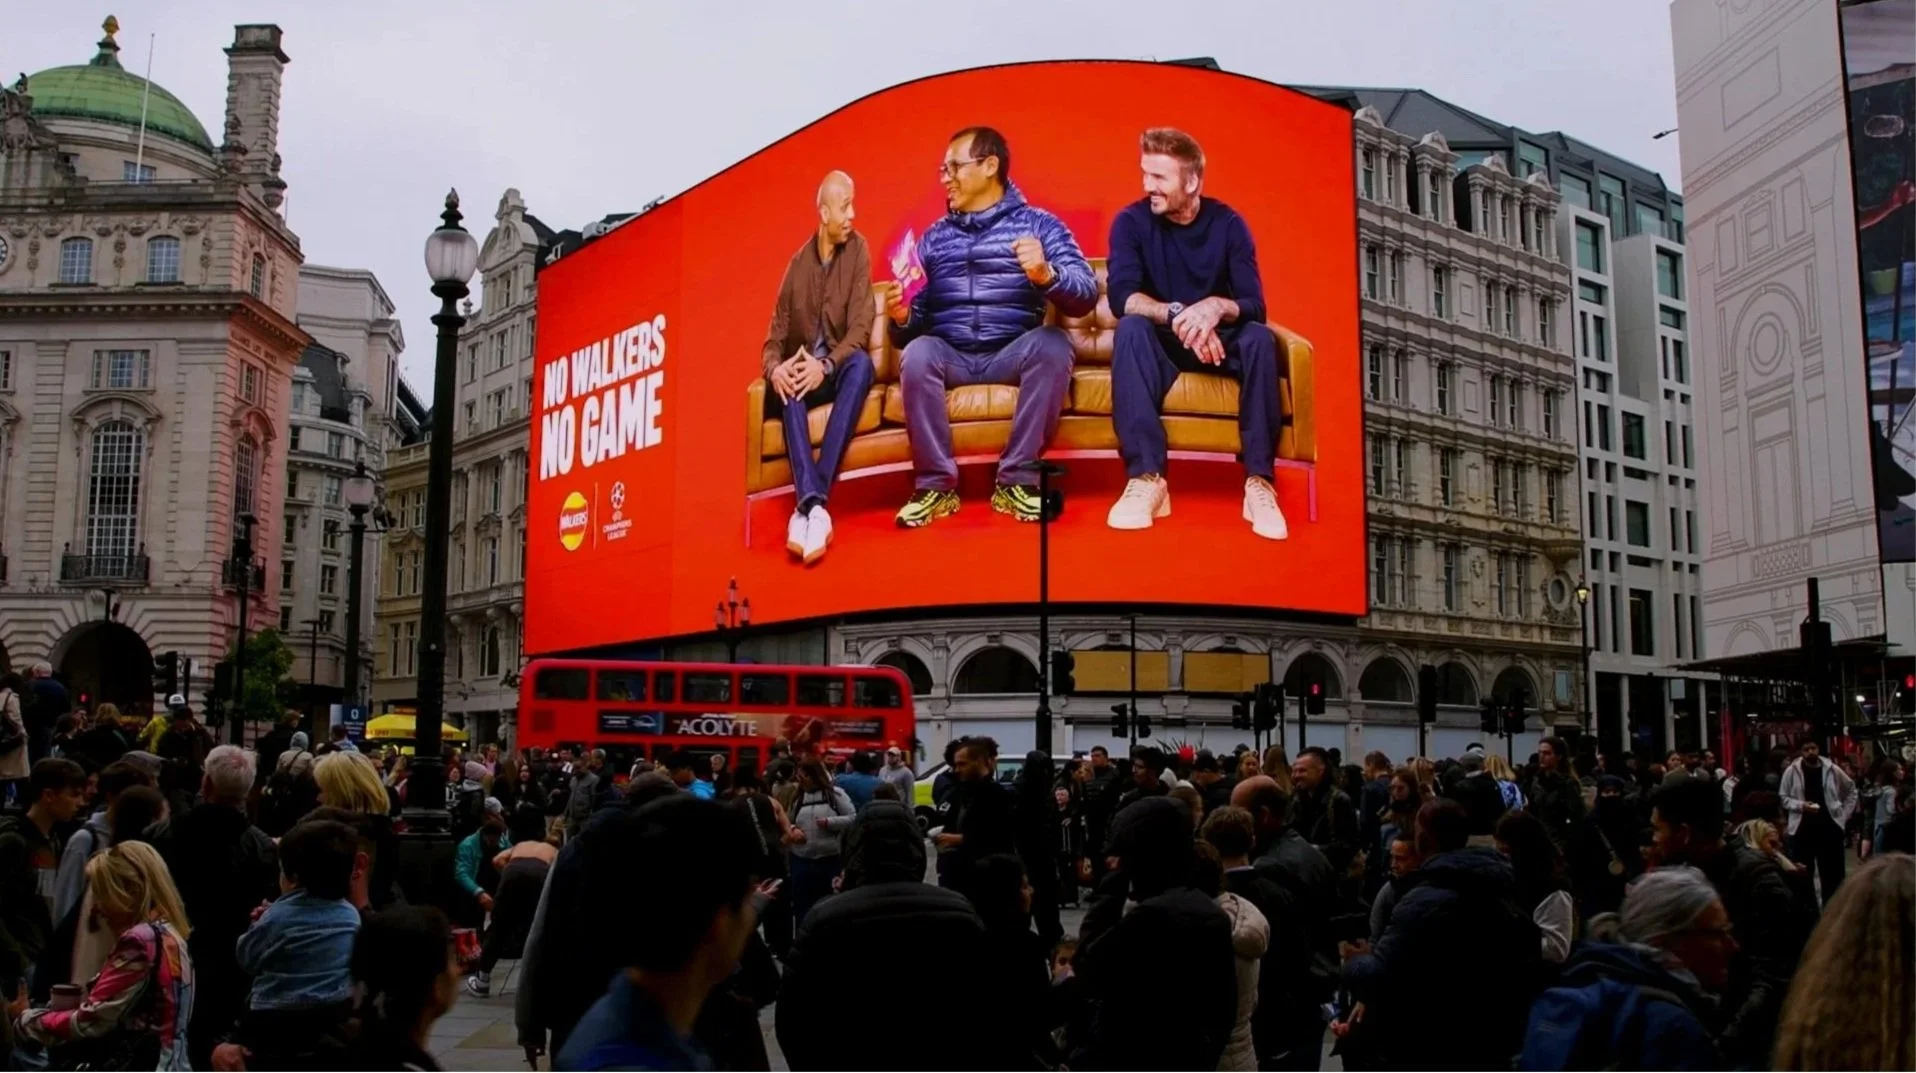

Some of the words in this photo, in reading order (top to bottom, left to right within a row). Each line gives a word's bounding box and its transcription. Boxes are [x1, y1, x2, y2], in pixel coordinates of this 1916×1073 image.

[543, 356, 568, 410] NO
[571, 314, 666, 399] WALKERS
[540, 404, 575, 481] NO
[581, 370, 664, 468] GAME
[560, 511, 588, 530] WALKERS
[677, 719, 757, 736] ACOLYTE
